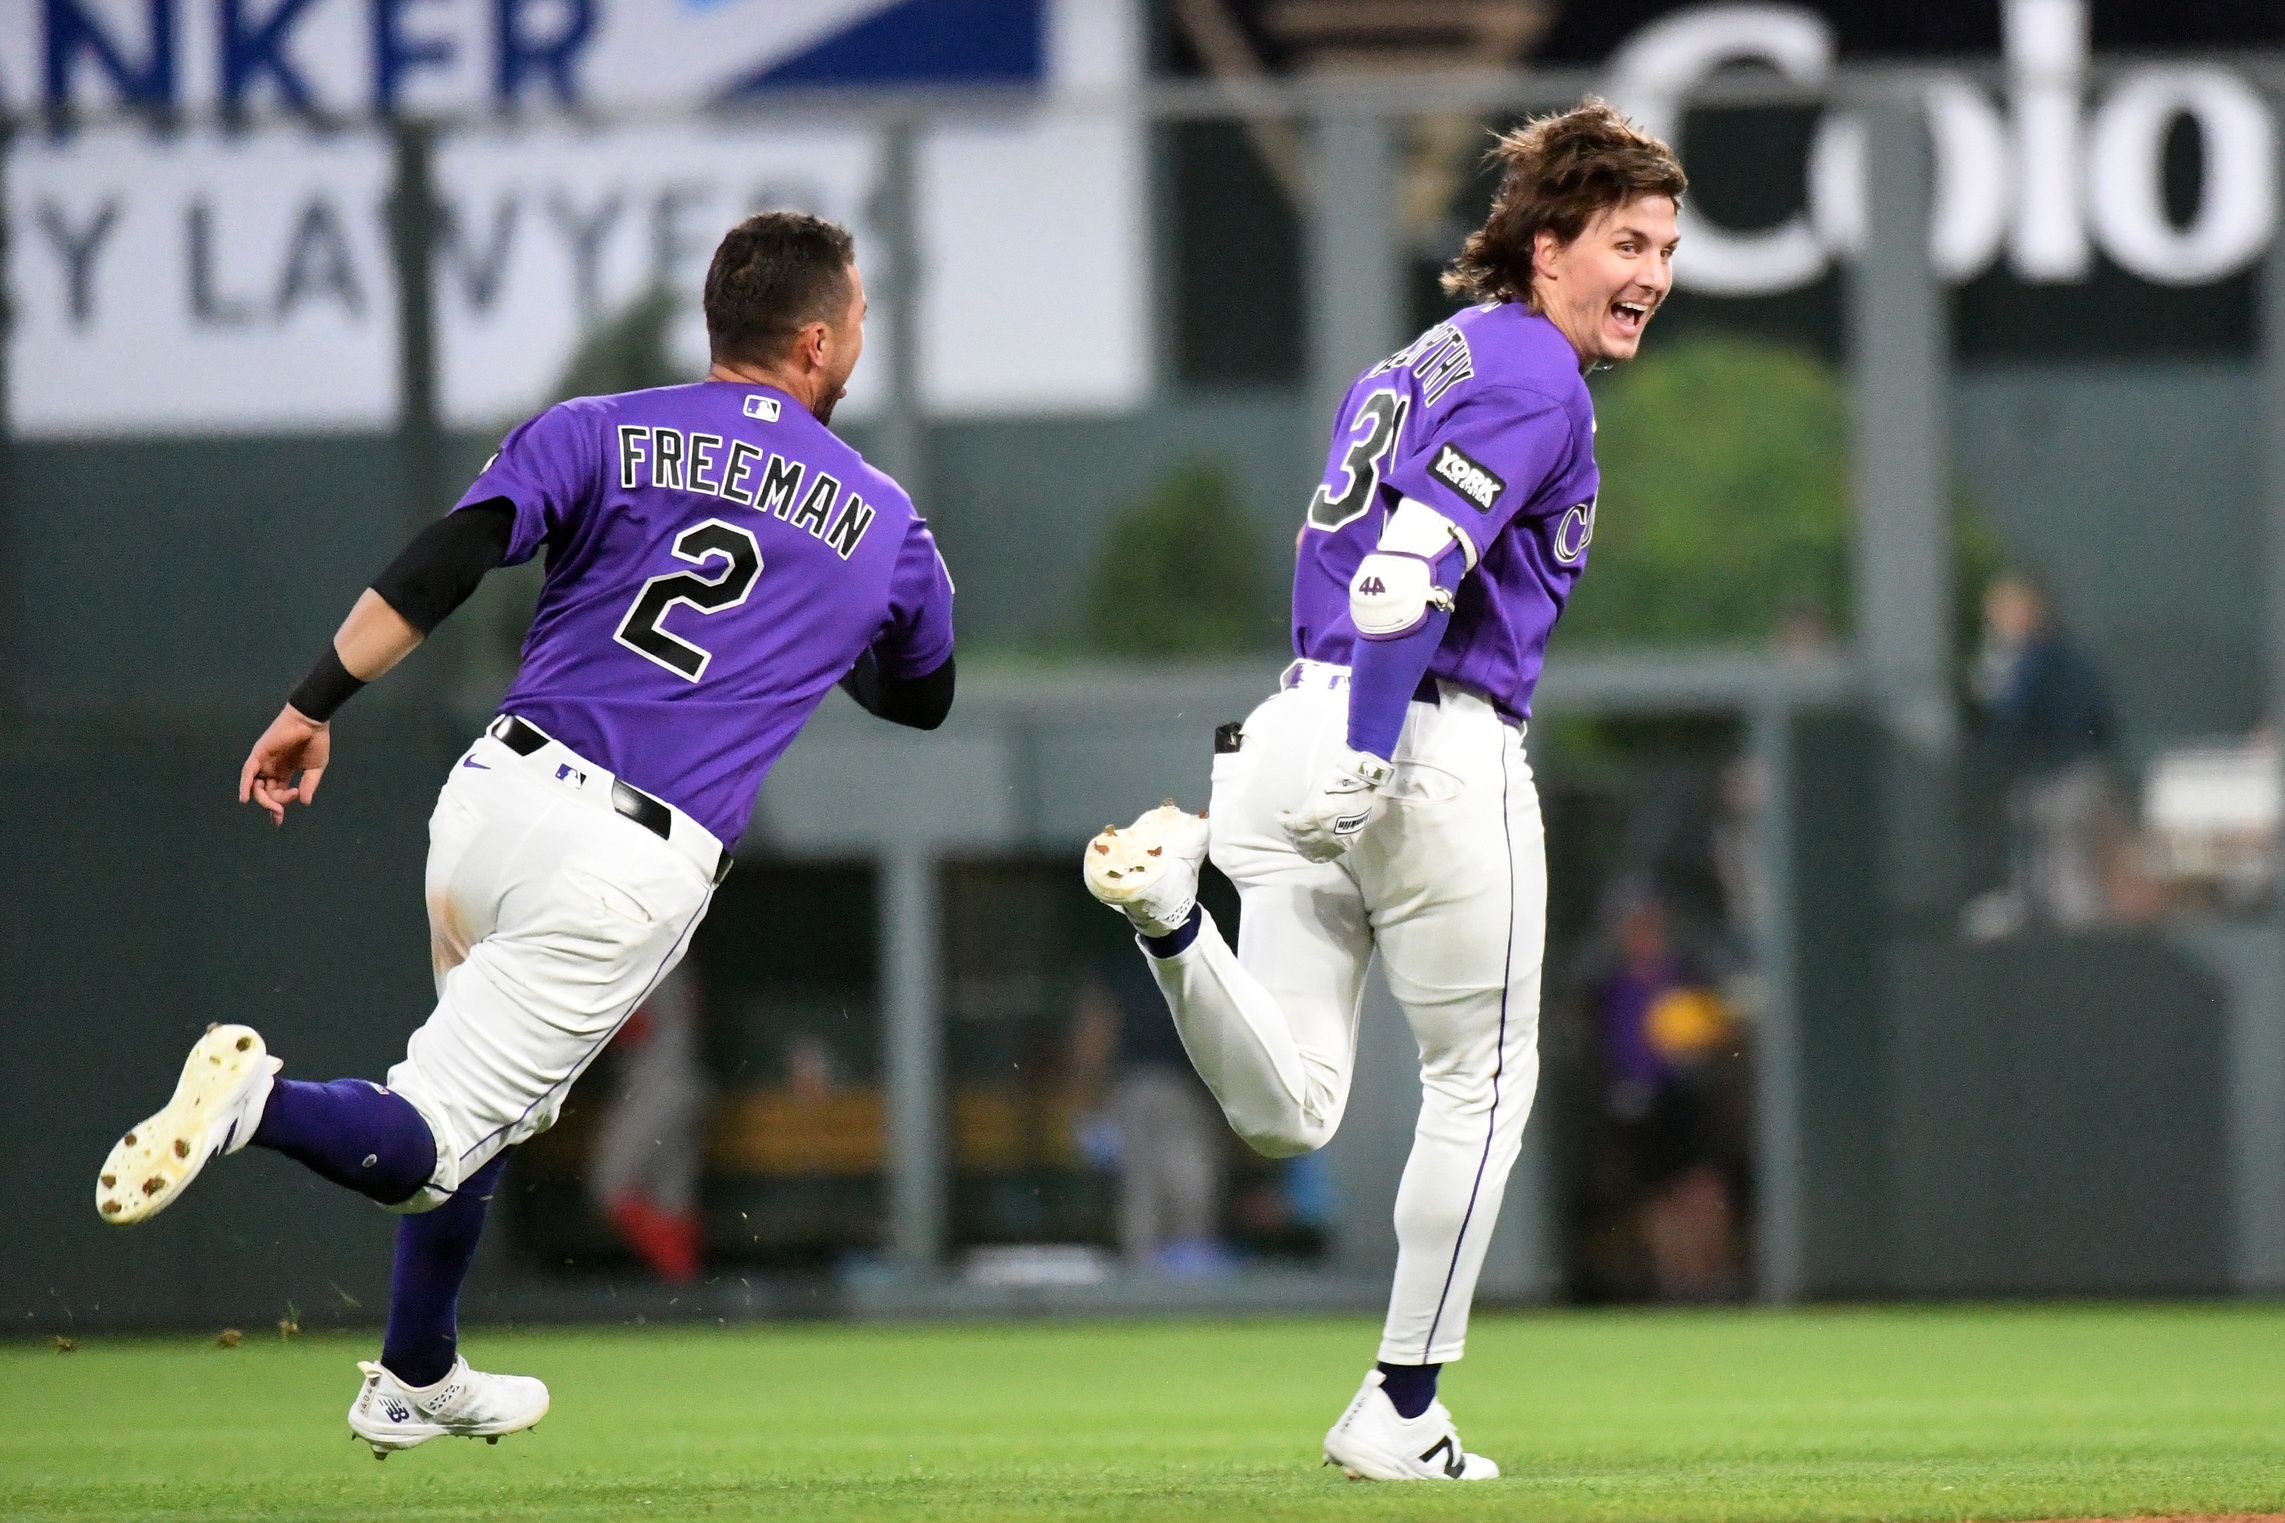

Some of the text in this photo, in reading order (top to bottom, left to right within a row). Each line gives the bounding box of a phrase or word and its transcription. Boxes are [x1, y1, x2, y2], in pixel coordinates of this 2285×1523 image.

[618, 425, 876, 561] FREEMAN
[1439, 446, 1501, 500] YORK
[612, 518, 765, 683] 2
